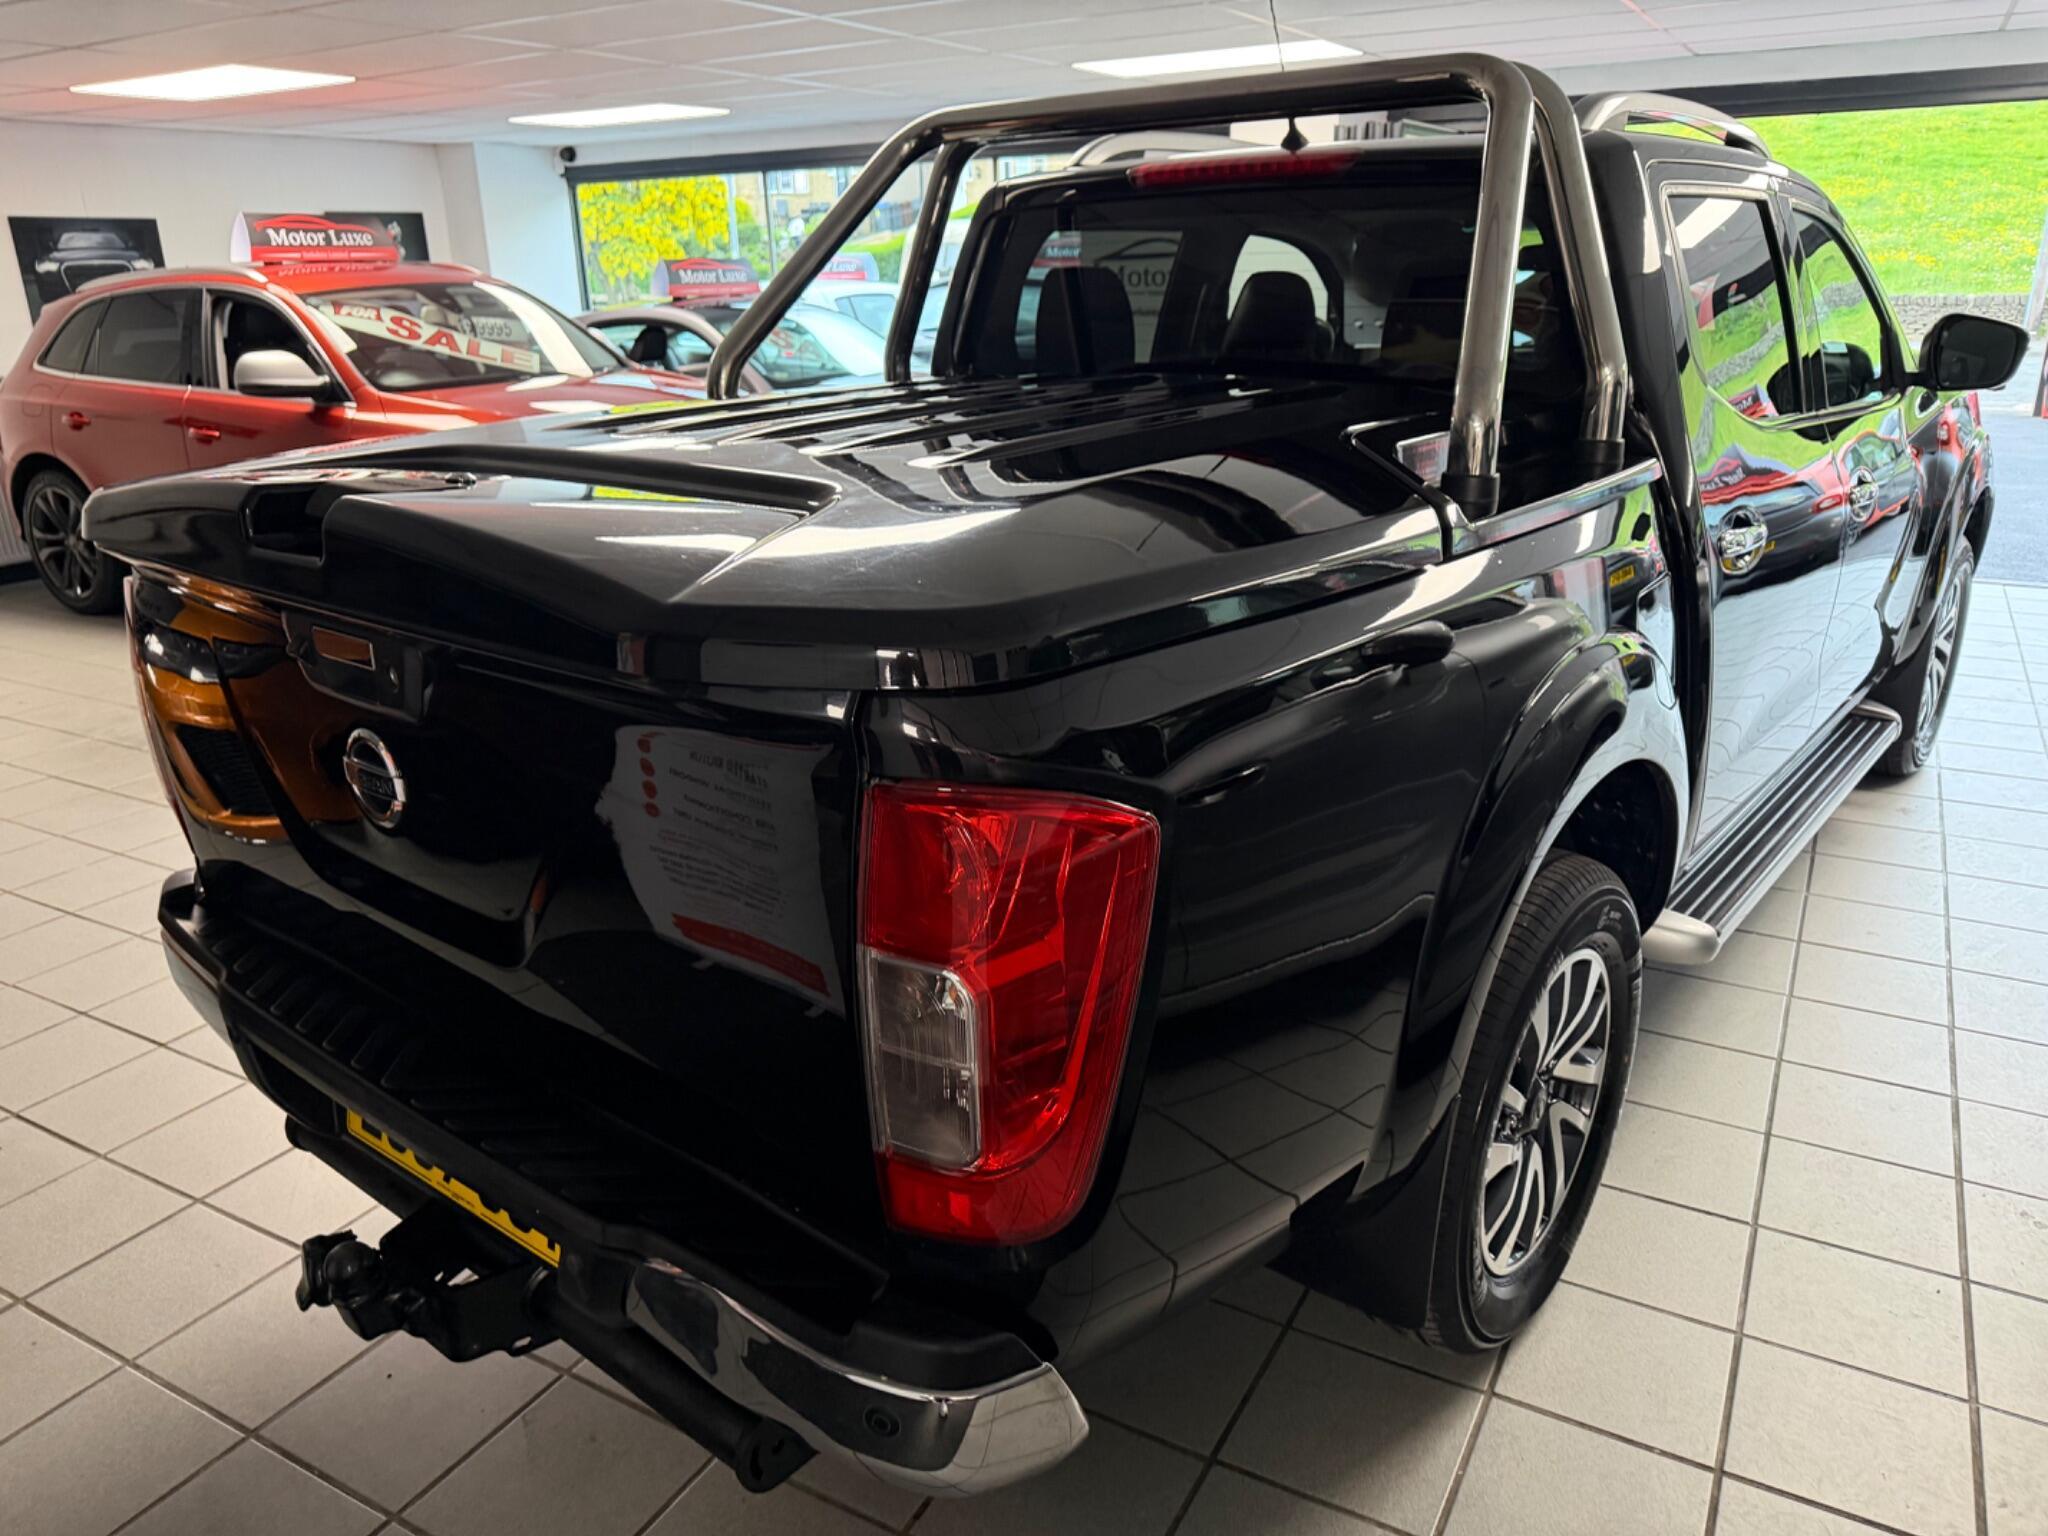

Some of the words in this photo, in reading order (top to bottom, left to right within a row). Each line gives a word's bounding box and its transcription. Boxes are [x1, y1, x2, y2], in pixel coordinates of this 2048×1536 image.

[266, 228, 325, 246] Motor
[328, 229, 373, 246] Luxe
[679, 269, 717, 284] Motor
[340, 304, 378, 320] FOR
[386, 316, 533, 368] SALE
